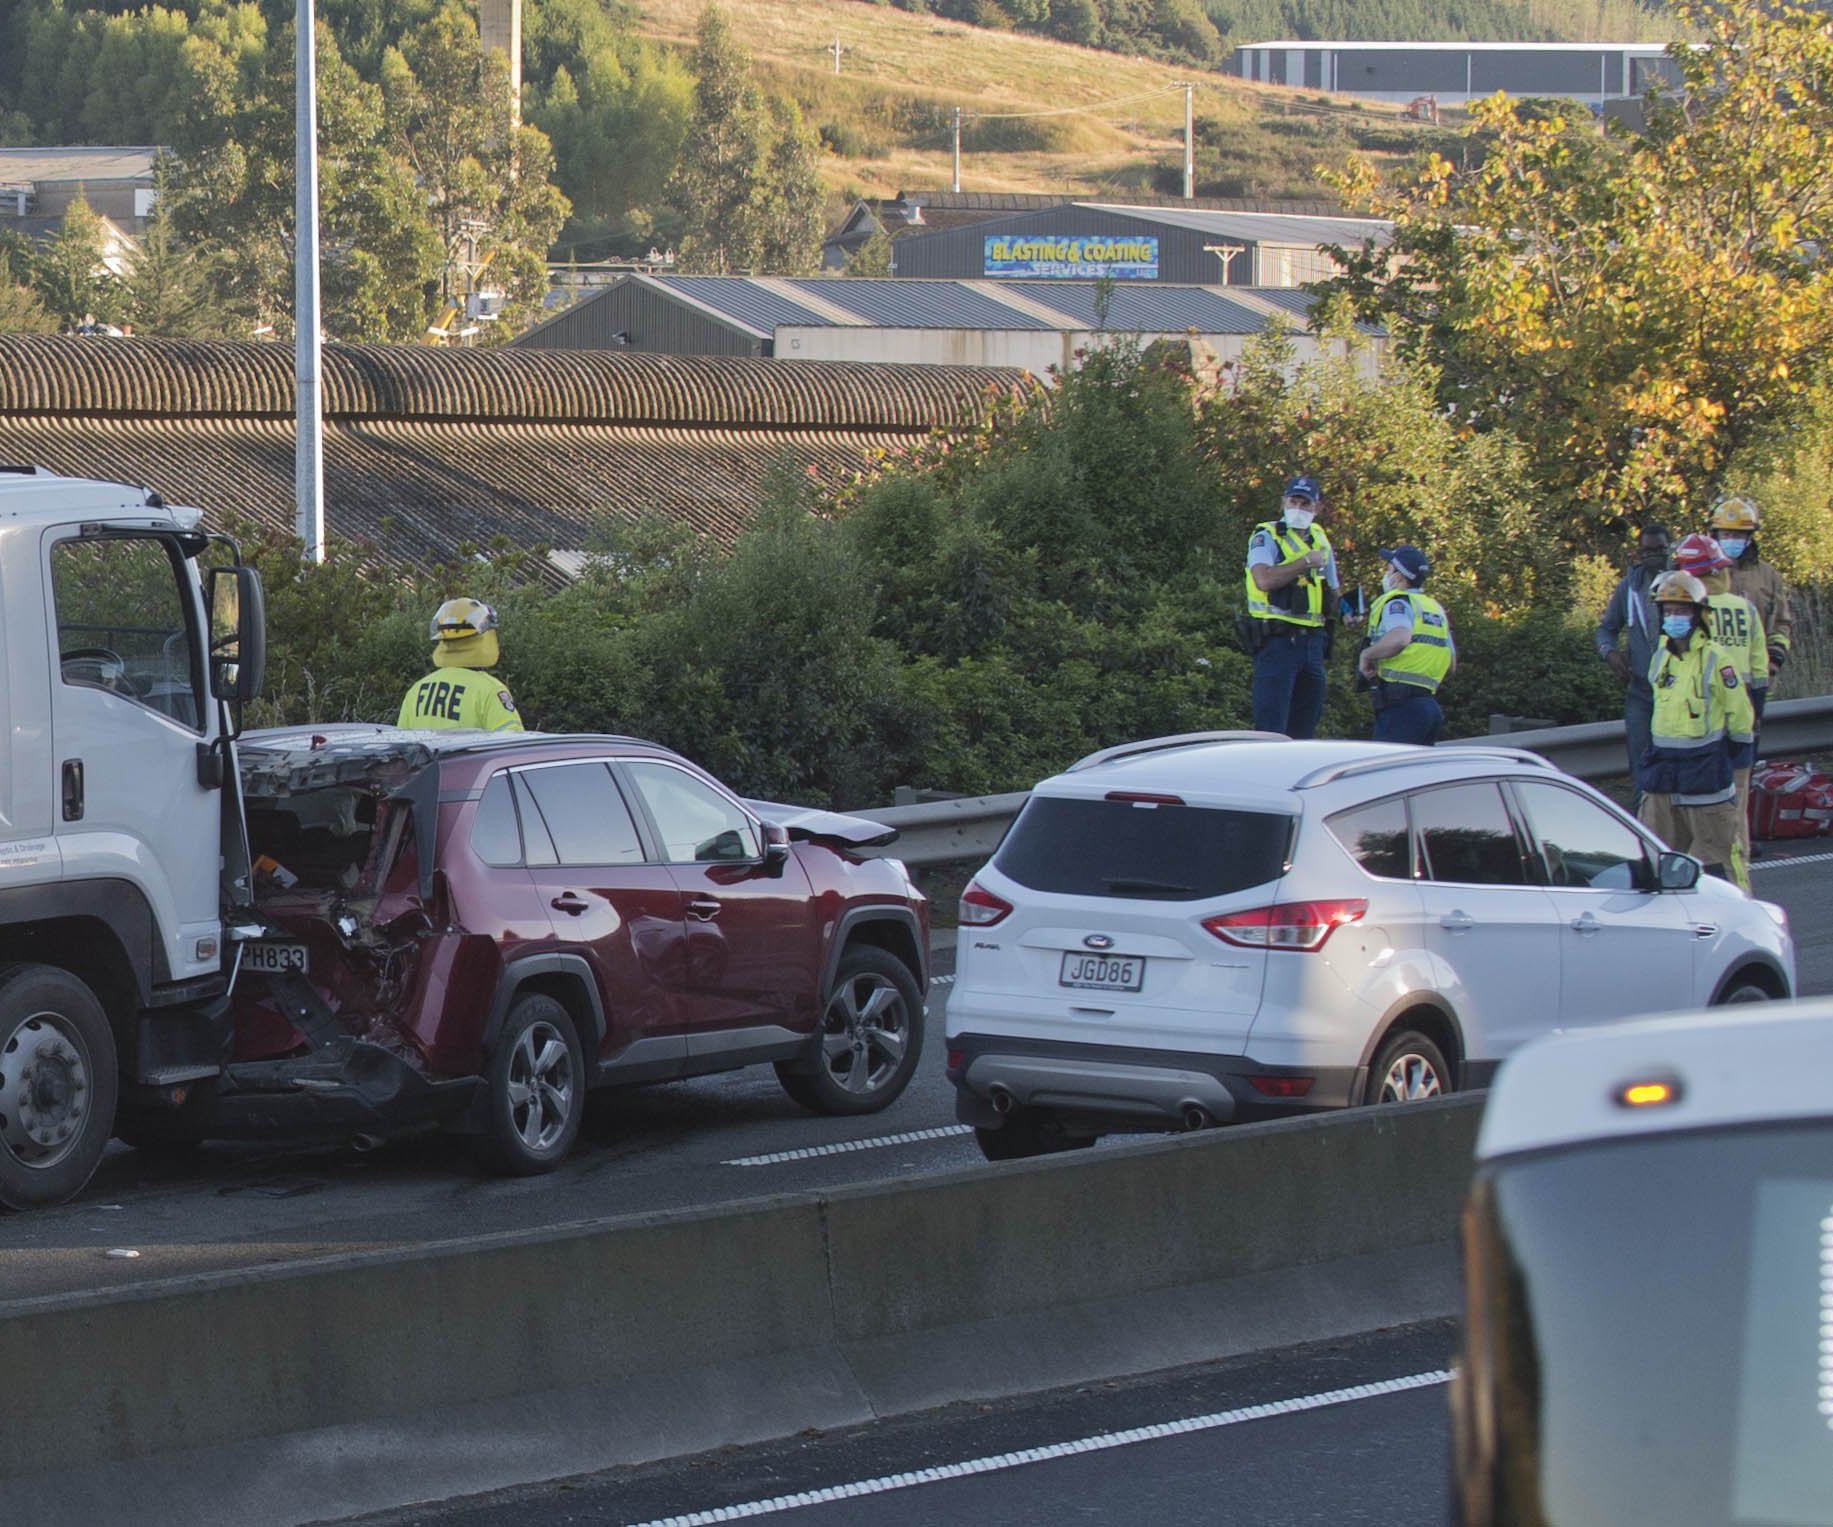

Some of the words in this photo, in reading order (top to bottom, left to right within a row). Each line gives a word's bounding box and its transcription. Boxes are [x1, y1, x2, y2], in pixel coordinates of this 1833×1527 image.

[992, 242, 1067, 262] BLASTING
[1067, 240, 1080, 263] &
[1083, 242, 1152, 262] COATING
[1032, 263, 1106, 276] SERVICES
[415, 681, 467, 721] FIRE
[1071, 958, 1134, 984] JGD86
